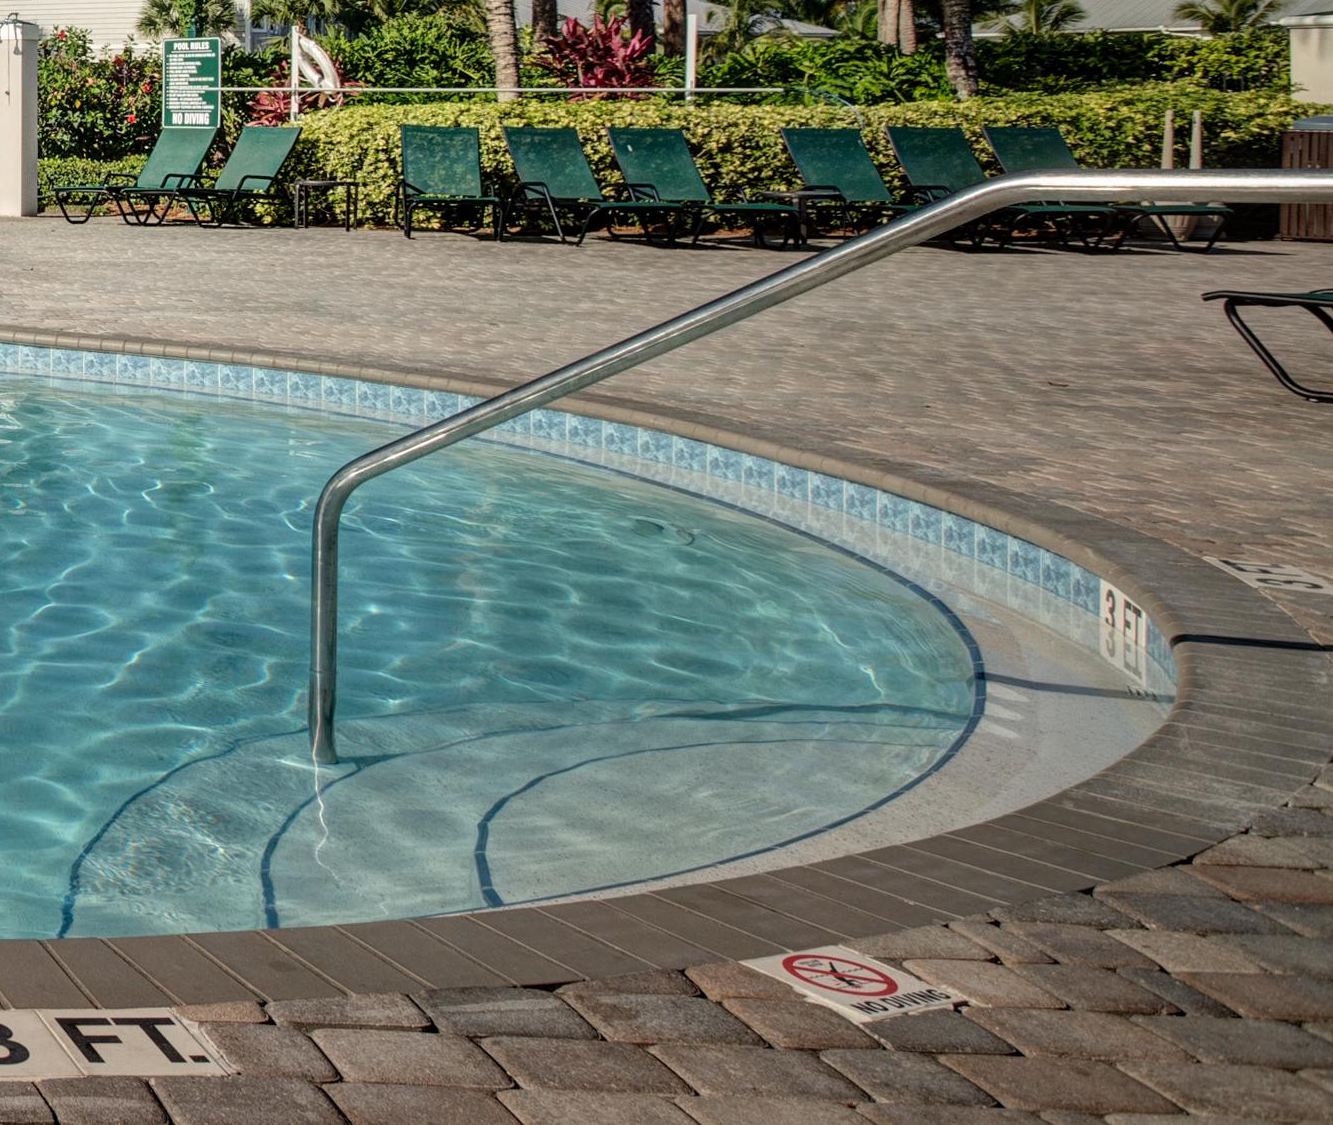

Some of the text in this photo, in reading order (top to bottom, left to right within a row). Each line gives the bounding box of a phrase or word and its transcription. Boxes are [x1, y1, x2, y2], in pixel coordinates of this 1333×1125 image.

[173, 42, 210, 50] POOL RULES
[172, 113, 210, 125] NO DIVING
[1105, 589, 1142, 646] 3 FT
[851, 988, 952, 1015] NO DIVING
[54, 1016, 211, 1064] FT.
